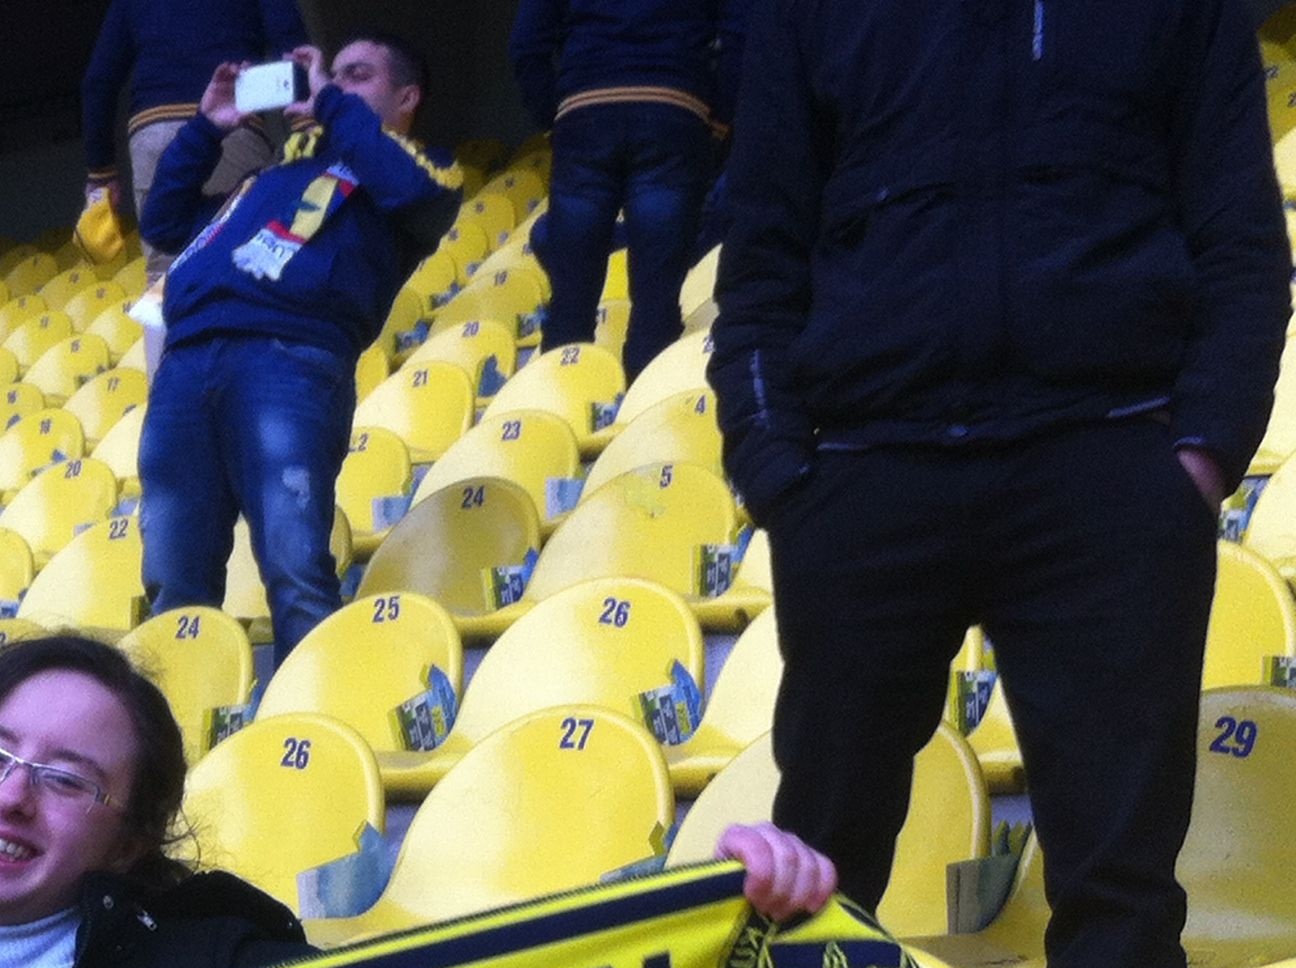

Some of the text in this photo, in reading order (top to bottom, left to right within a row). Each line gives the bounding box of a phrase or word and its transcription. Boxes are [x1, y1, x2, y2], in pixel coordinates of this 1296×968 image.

[461, 321, 480, 337] 20
[560, 347, 581, 365] 22
[412, 368, 429, 386] 21
[501, 421, 521, 441] 23
[63, 459, 83, 479] 20
[461, 485, 485, 509] 24
[108, 518, 129, 540] 22
[372, 595, 400, 623] 25
[598, 597, 632, 627] 26
[177, 615, 201, 639] 24
[558, 716, 594, 750] 27
[1209, 715, 1257, 758] 29
[279, 736, 311, 769] 26
